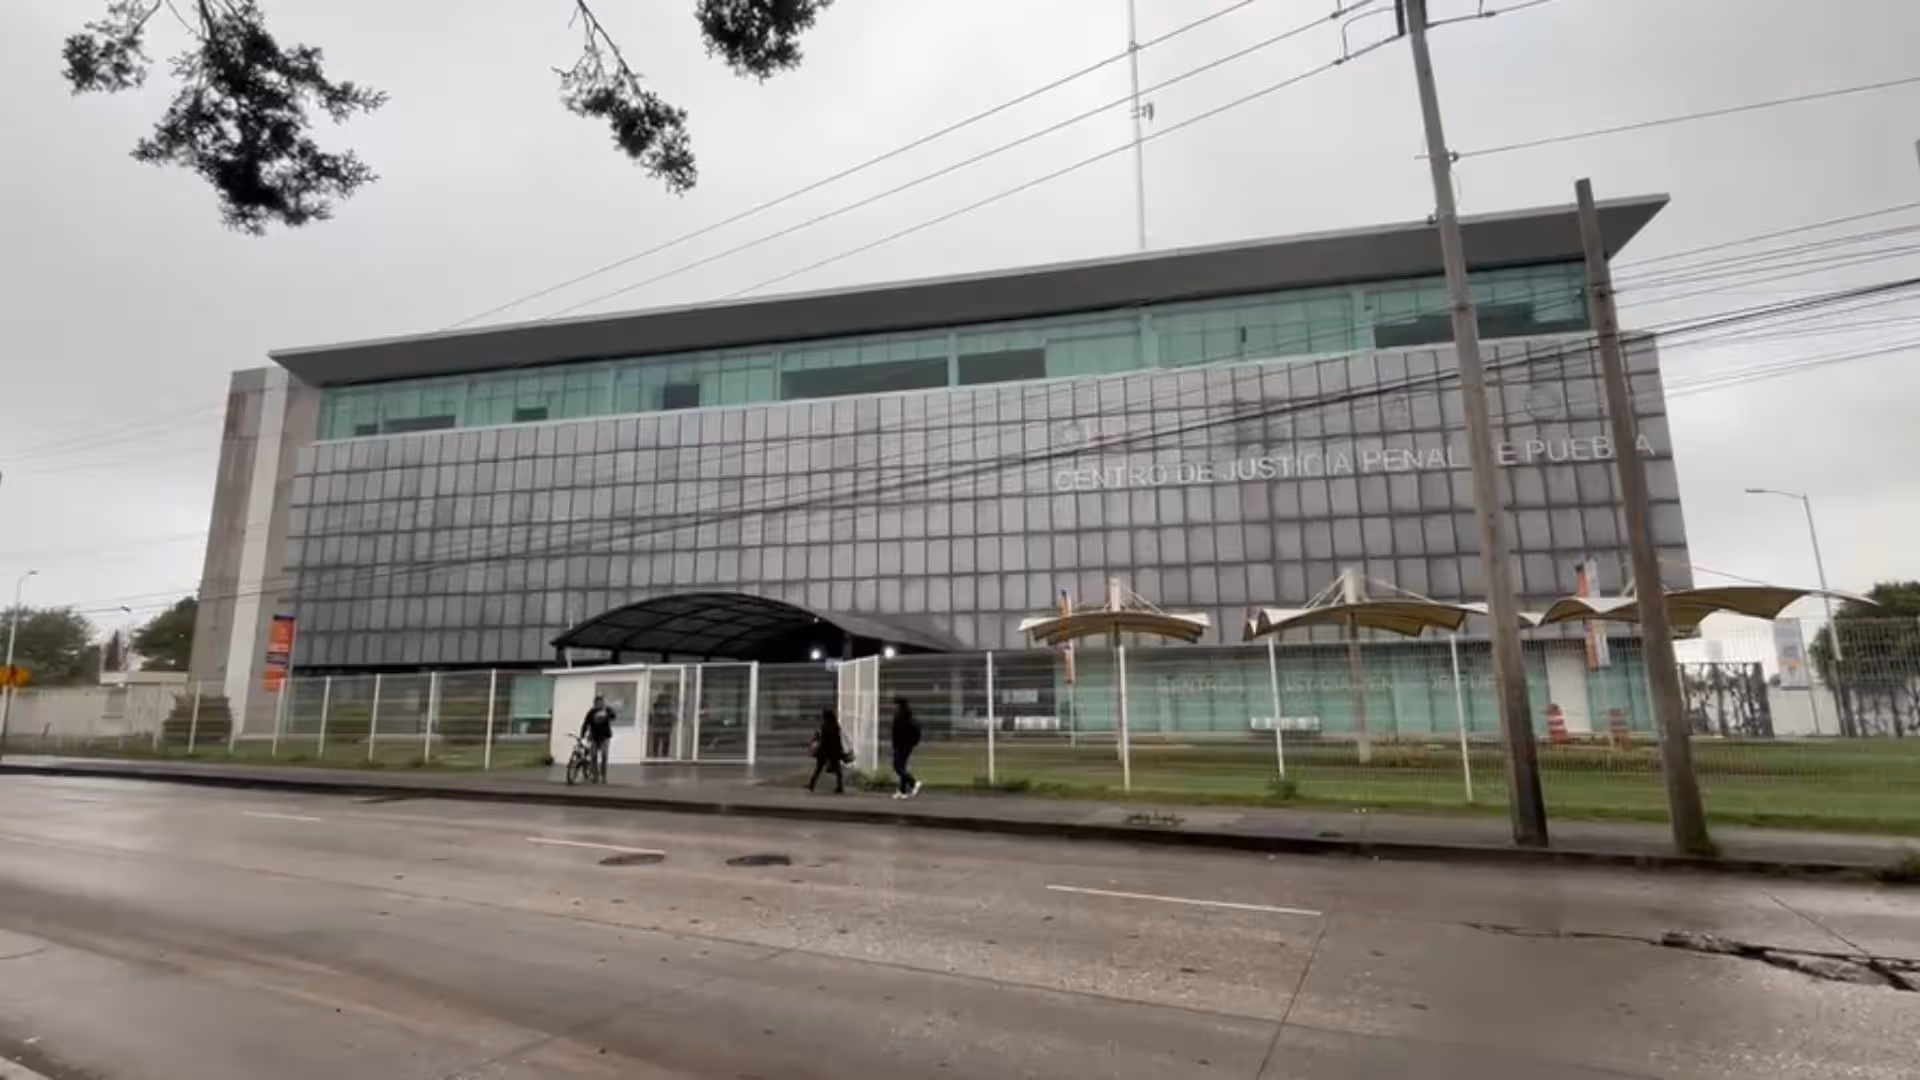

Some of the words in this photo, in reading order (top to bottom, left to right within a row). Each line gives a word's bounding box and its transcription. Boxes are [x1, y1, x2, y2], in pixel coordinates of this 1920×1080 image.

[1055, 463, 1167, 491] CENTRO
[1177, 460, 1213, 483] DE
[1223, 451, 1354, 482] JUSTICIA
[1361, 445, 1465, 473] PENAL
[1525, 433, 1657, 464] PUEBA
